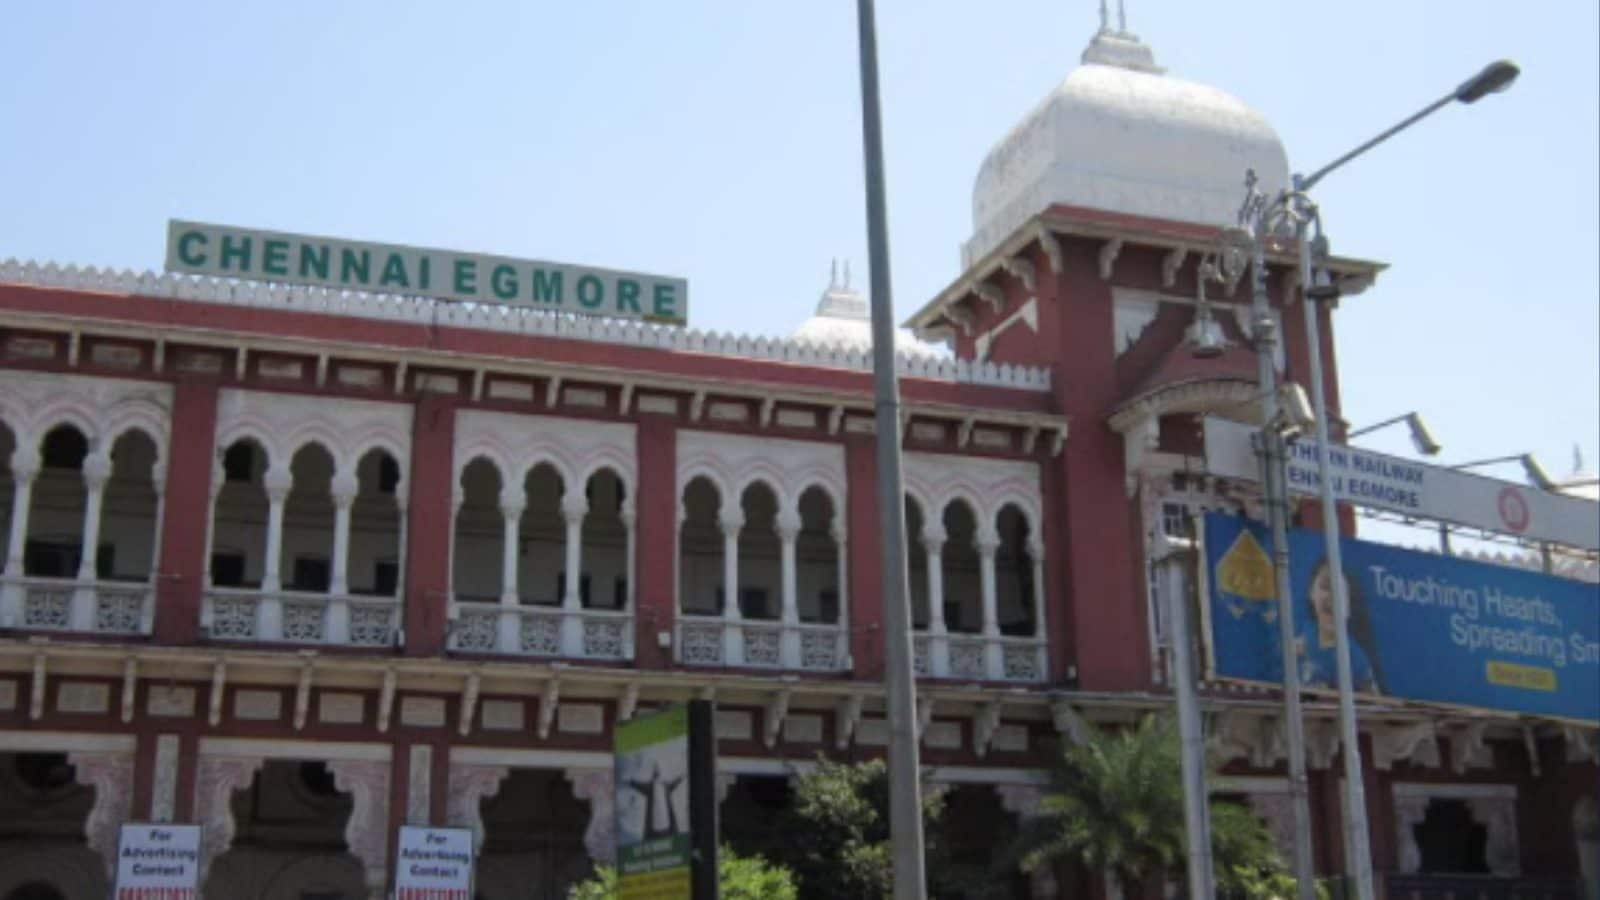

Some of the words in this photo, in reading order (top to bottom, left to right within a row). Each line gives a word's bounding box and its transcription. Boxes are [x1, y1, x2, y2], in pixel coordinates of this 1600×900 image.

[176, 230, 430, 290] CHENNAI
[454, 258, 677, 317] EGMORE
[1352, 453, 1423, 484] RAILWAY
[1348, 478, 1419, 507] EGMORE
[1369, 565, 1479, 620] Touching
[1484, 585, 1562, 629] Hearts,
[1450, 613, 1566, 668] Spreading
[121, 847, 196, 862] Advertising
[401, 848, 469, 865] Advertising
